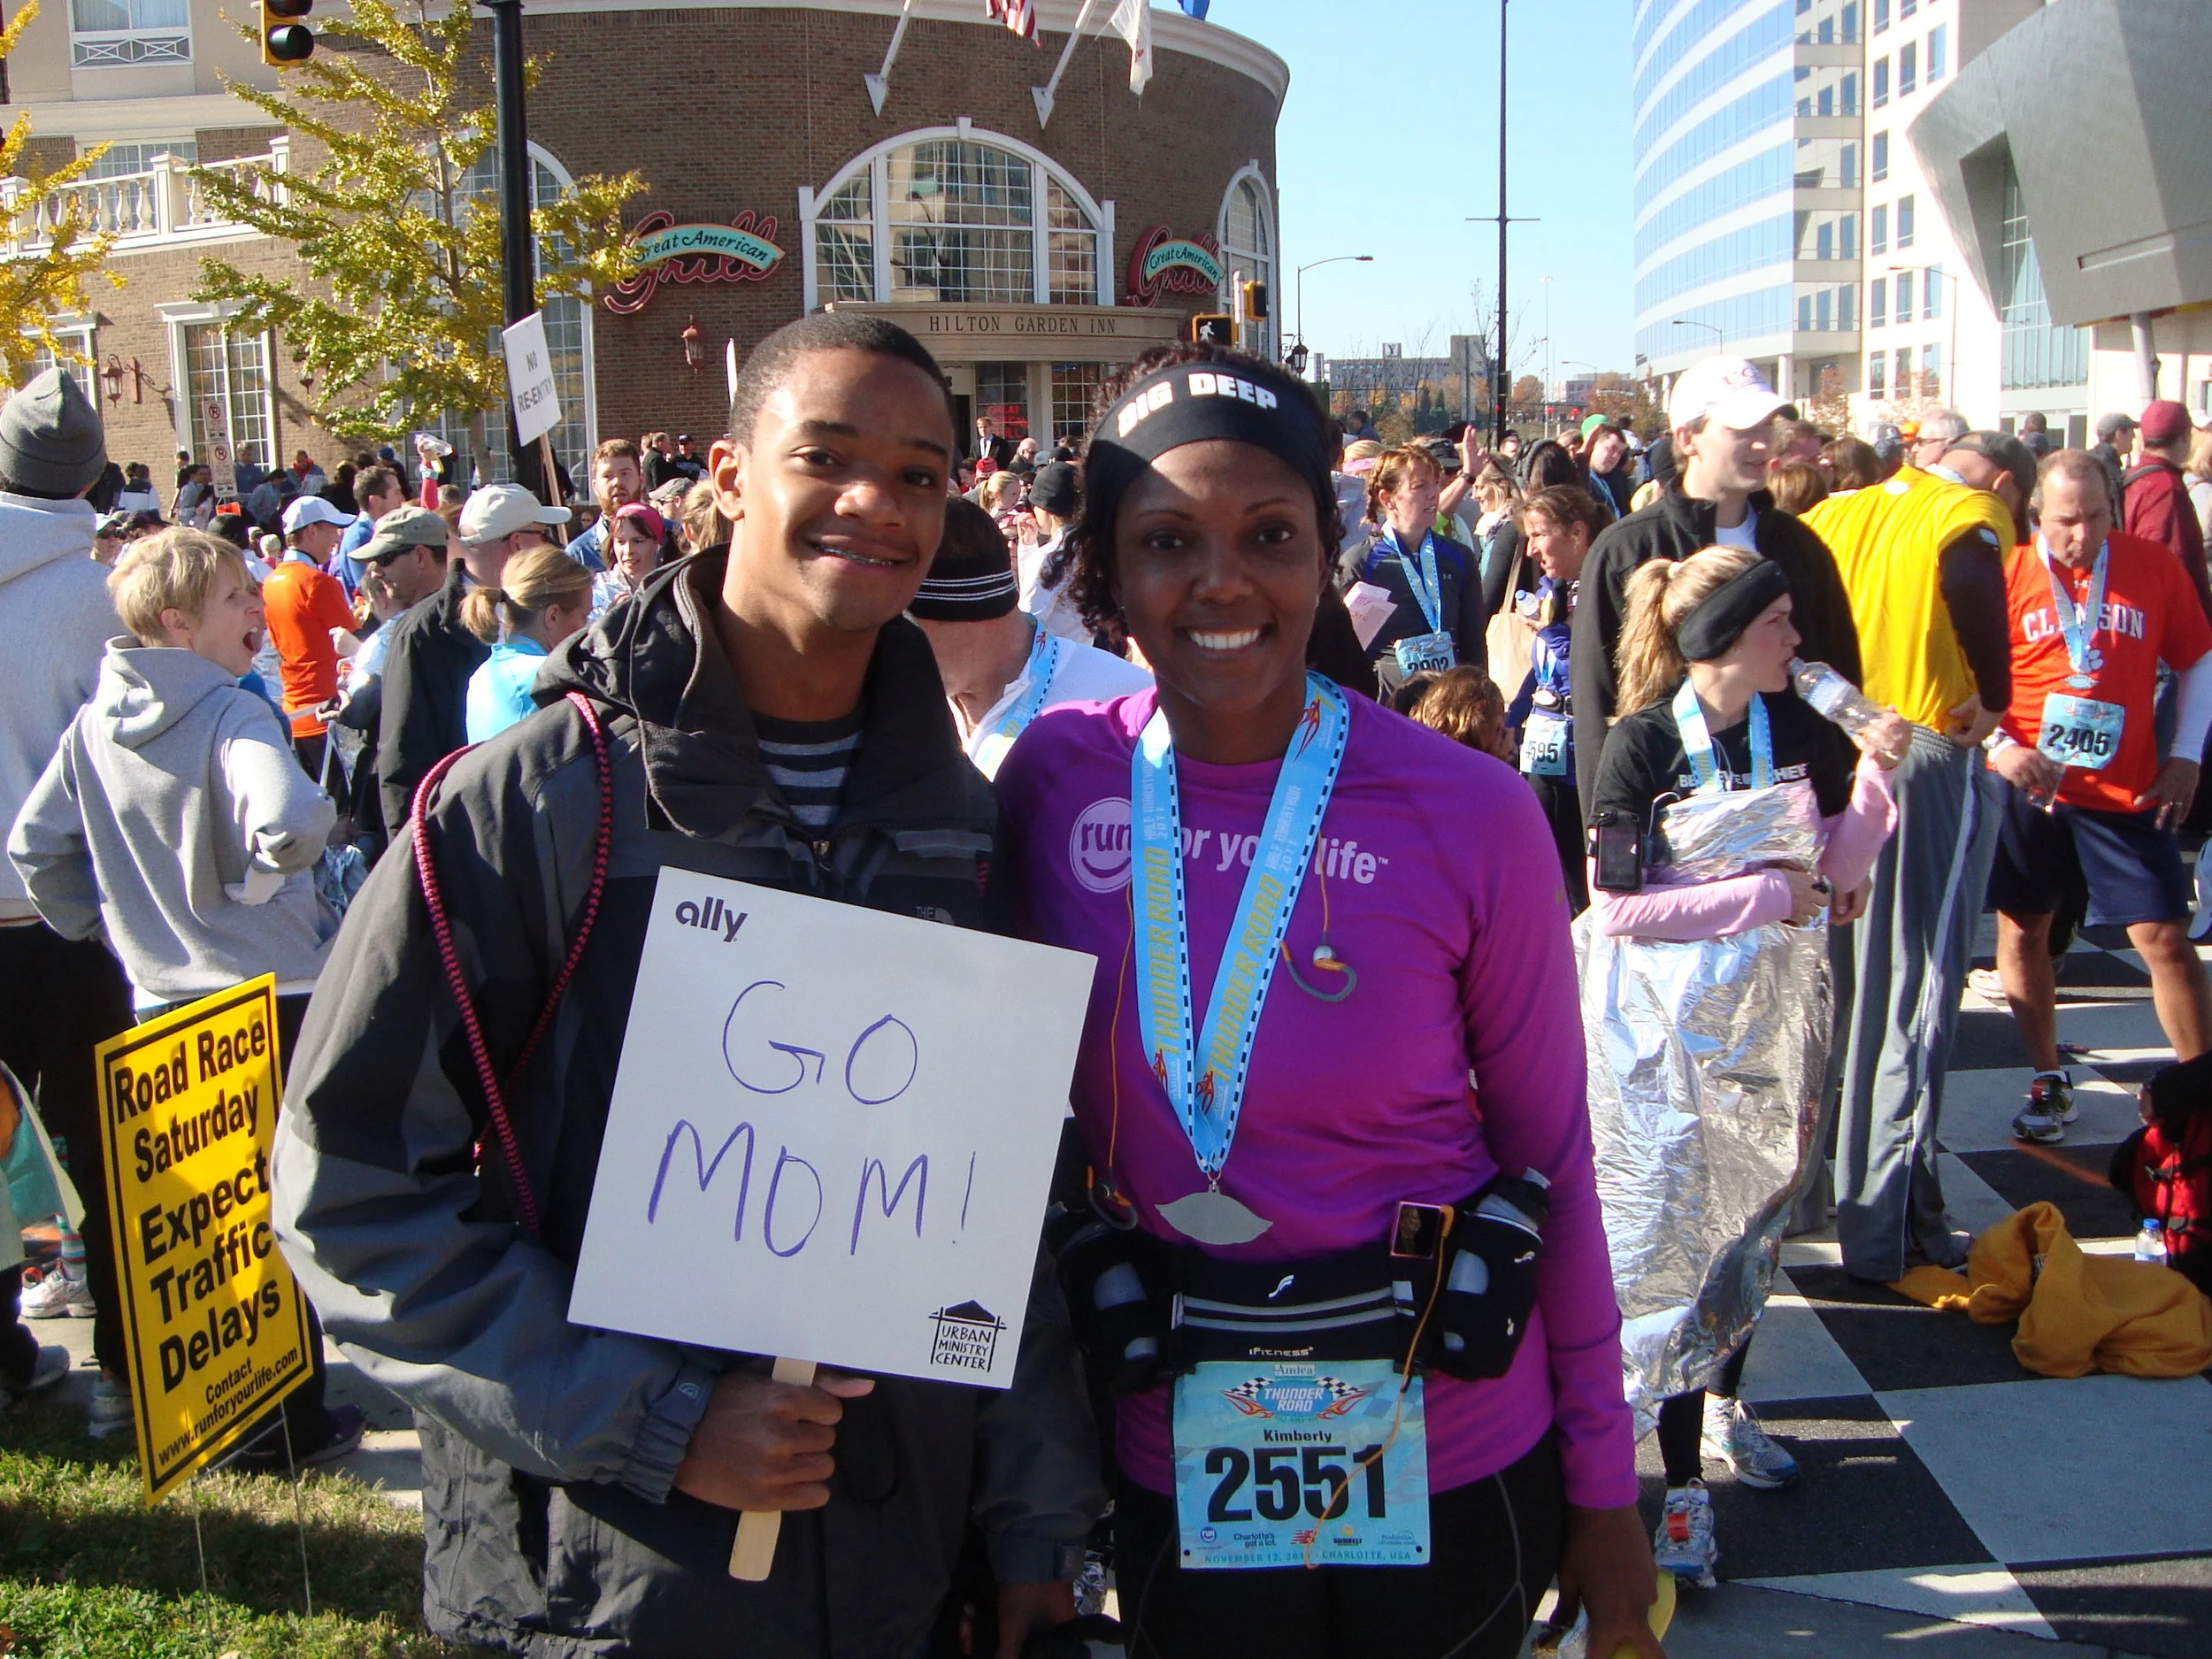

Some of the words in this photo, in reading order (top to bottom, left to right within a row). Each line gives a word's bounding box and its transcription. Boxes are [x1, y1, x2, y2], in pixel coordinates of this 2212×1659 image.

[632, 233, 680, 263] Great
[681, 230, 769, 262] American
[1149, 248, 1175, 269] Great
[1175, 246, 1218, 279] American
[929, 316, 1001, 332] HILTON
[1014, 317, 1079, 333] GARDEN
[1090, 319, 1116, 333] INN
[526, 350, 538, 373] NO
[517, 374, 554, 413] RE-ENTRY
[1118, 380, 1174, 438] DIG
[1187, 373, 1279, 410] DEEP
[2047, 724, 2112, 757] 2405
[1179, 827, 1211, 860] or
[1144, 847, 1172, 924] ROAD
[675, 896, 748, 942] ally
[1148, 925, 1180, 1054] THUNDER
[1208, 951, 1260, 1082] THUNDER
[1241, 873, 1283, 956] ROAD
[722, 980, 918, 1105] GO
[114, 1040, 188, 1125] Road
[196, 1019, 266, 1084] Race
[134, 1085, 259, 1184] Saturday
[140, 1146, 271, 1266] Expect
[647, 1118, 976, 1258] MOM!
[150, 1220, 273, 1325] Traffic
[158, 1279, 281, 1395] Delays
[938, 1339, 990, 1357] MINISTRY
[941, 1325, 992, 1344] URBAN
[205, 1356, 253, 1405] Contact
[935, 1352, 987, 1371] CENTER
[1278, 1365, 1314, 1375] Amica
[157, 1347, 299, 1467] www.runforyourlife.com
[1264, 1387, 1325, 1401] THUNDER
[1277, 1399, 1314, 1413] ROAD
[1263, 1429, 1333, 1443] Kimberly
[1205, 1443, 1386, 1523] 2551
[1205, 1554, 1263, 1563] NOVEMBER
[1322, 1550, 1386, 1561] CHARLOTTE,
[1390, 1551, 1411, 1560] USA
